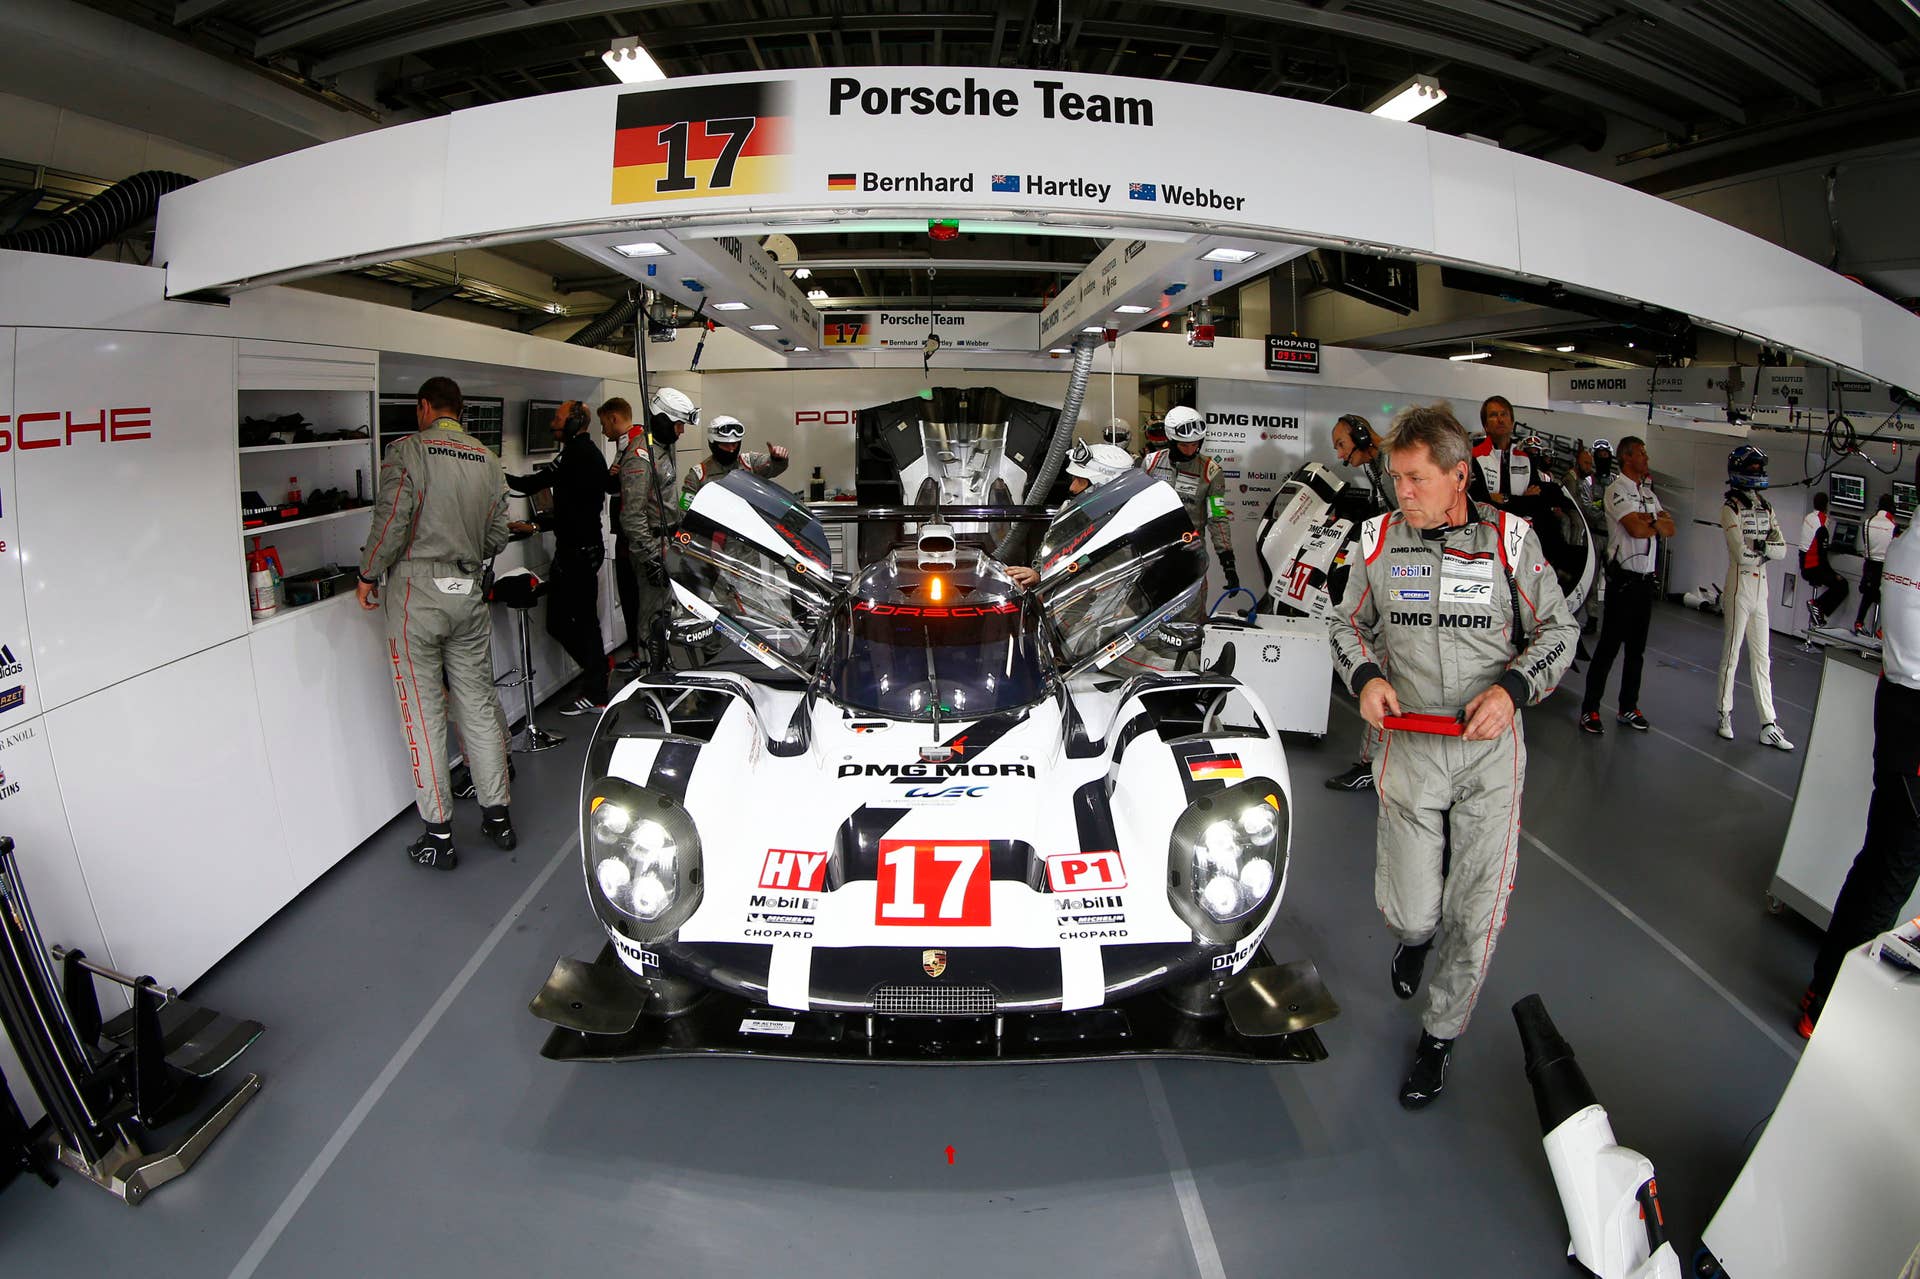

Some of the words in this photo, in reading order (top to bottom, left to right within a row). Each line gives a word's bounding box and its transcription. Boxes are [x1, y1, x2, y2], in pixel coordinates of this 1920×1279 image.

[829, 77, 1019, 117] Porsche
[1033, 80, 1154, 127] Team
[655, 115, 757, 193] 17
[862, 171, 974, 193] Bernhard
[1026, 175, 1112, 203] Hartley
[1161, 184, 1246, 212] Webber
[880, 313, 930, 326] Porsche
[932, 314, 965, 326] Team
[835, 323, 863, 344] 17
[889, 339, 918, 347] Bernhard
[965, 340, 989, 348] Webber
[1270, 338, 1317, 349] CHOPARD
[1569, 379, 1596, 390] DMG
[1597, 378, 1627, 390] MORI
[795, 410, 857, 425] PO
[1206, 412, 1249, 426] DMG
[1252, 415, 1298, 429] MORI
[0, 407, 152, 453] CHE
[1269, 433, 1298, 441] vodafone
[423, 440, 487, 453] PORSCHE
[428, 446, 457, 458] DMG
[458, 451, 486, 463] MORI
[1247, 471, 1269, 480] Mobil
[1322, 527, 1342, 540] MORI
[1391, 566, 1420, 577] Mobil
[1289, 565, 1312, 598] 17
[1453, 584, 1491, 594] WEC
[853, 602, 1019, 618] PORSCHE
[1391, 612, 1432, 626] DMG
[1439, 613, 1492, 629] MORI
[6, 728, 35, 747] KNOLL
[838, 764, 927, 778] DMG
[935, 764, 1036, 779] MORI
[904, 785, 990, 798] WEC
[760, 851, 826, 888] HY
[1061, 858, 1113, 885] P1
[881, 845, 983, 919] 17
[750, 895, 800, 909] Mobil
[1055, 897, 1104, 910] Mobil
[744, 929, 813, 939] CHOPARD
[1060, 930, 1128, 940] CHOPARD
[620, 942, 658, 966] MORI
[1213, 948, 1248, 969] DMG
